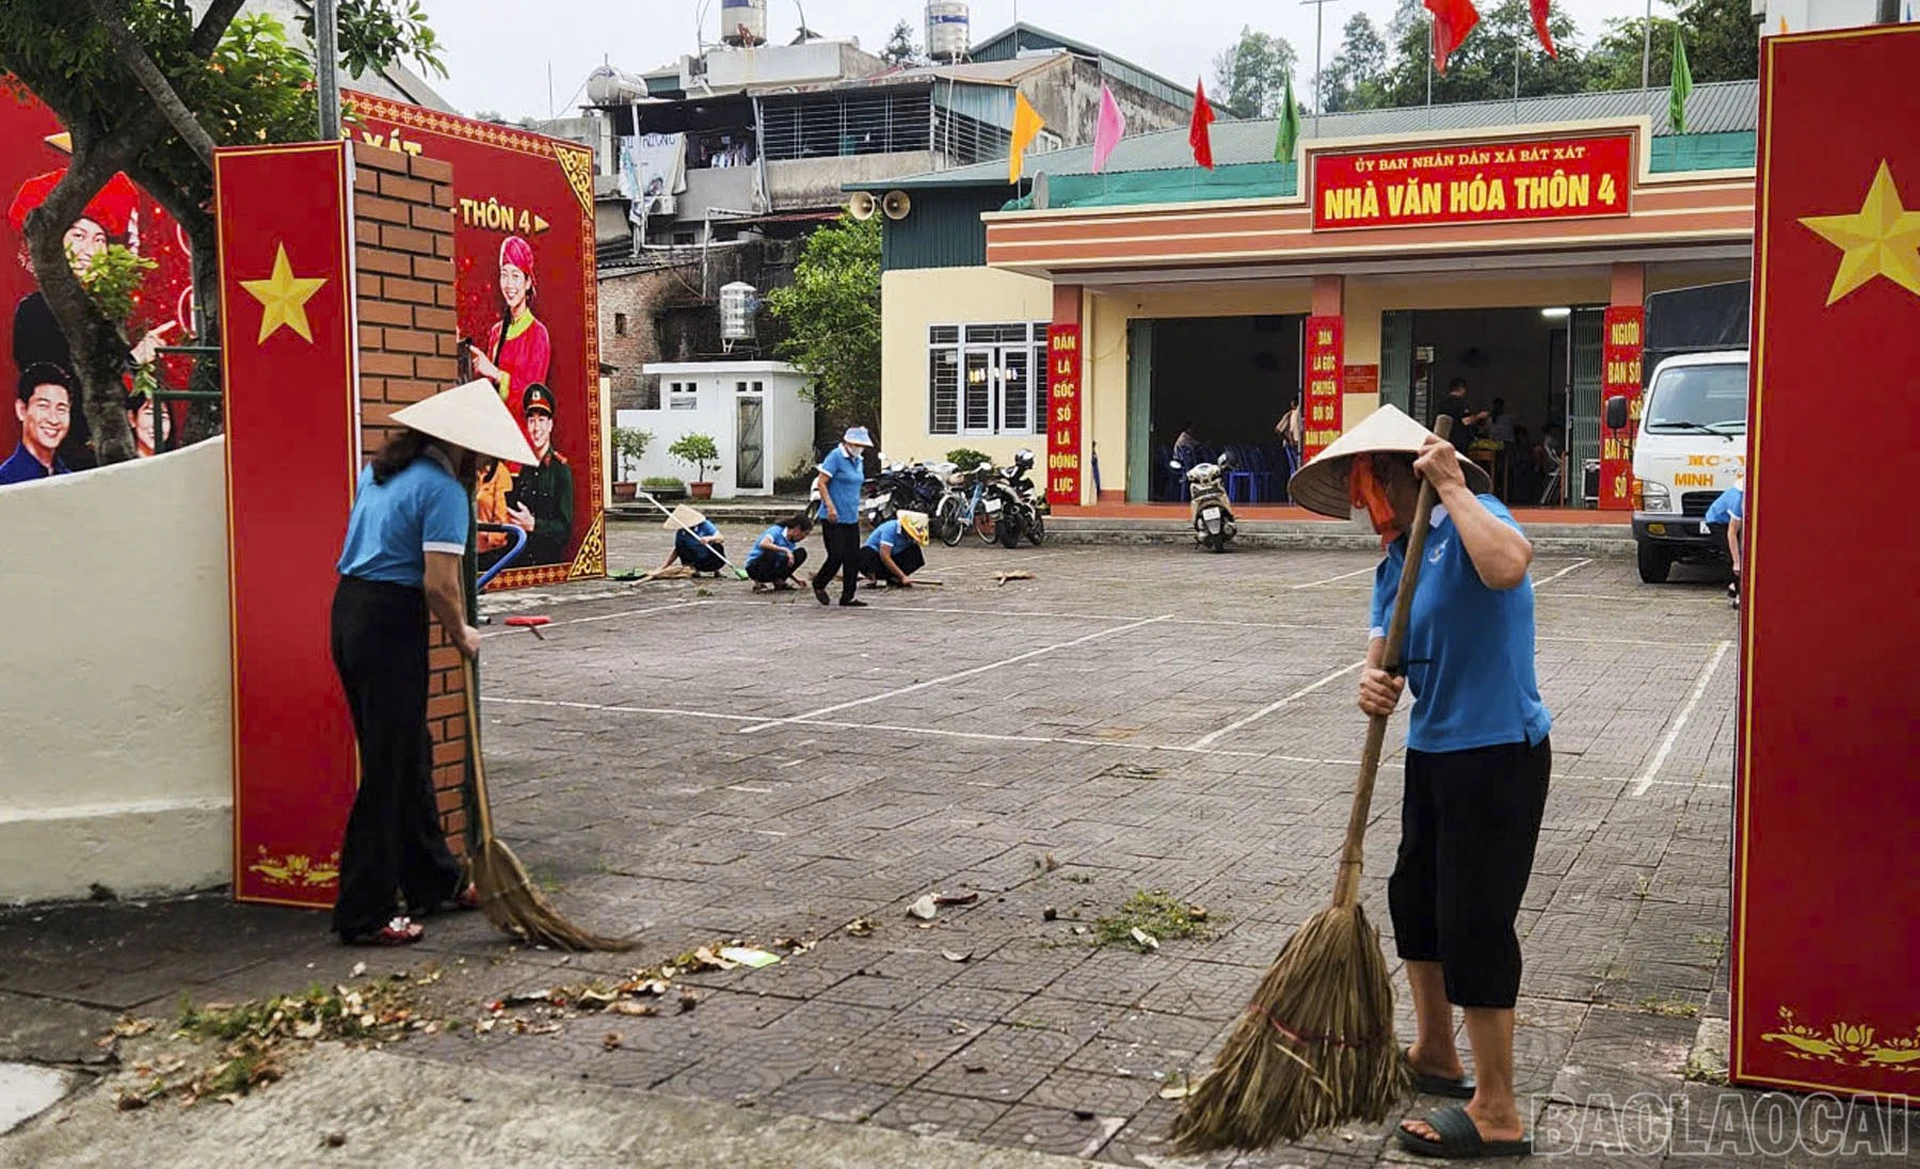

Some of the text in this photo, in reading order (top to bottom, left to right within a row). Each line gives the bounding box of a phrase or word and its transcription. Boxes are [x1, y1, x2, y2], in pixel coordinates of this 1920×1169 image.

[1355, 157, 1375, 172] ỦY
[1379, 158, 1409, 171] BAN
[1412, 153, 1454, 168] NHÂN
[1458, 150, 1490, 165] DÂN
[1325, 168, 1616, 220] NHÀ VĂN HÓA THÔN 4
[459, 196, 531, 234] THÔN 4
[1611, 319, 1640, 345] NGƯỜI
[1057, 357, 1071, 375] LÀ
[1053, 379, 1075, 398] GỐC
[1057, 402, 1071, 422] SỐ
[1057, 429, 1071, 446] LÀ
[1050, 452, 1078, 472] ĐỘNG
[1053, 476, 1074, 495] LỰC
[1674, 472, 1714, 488] MINH
